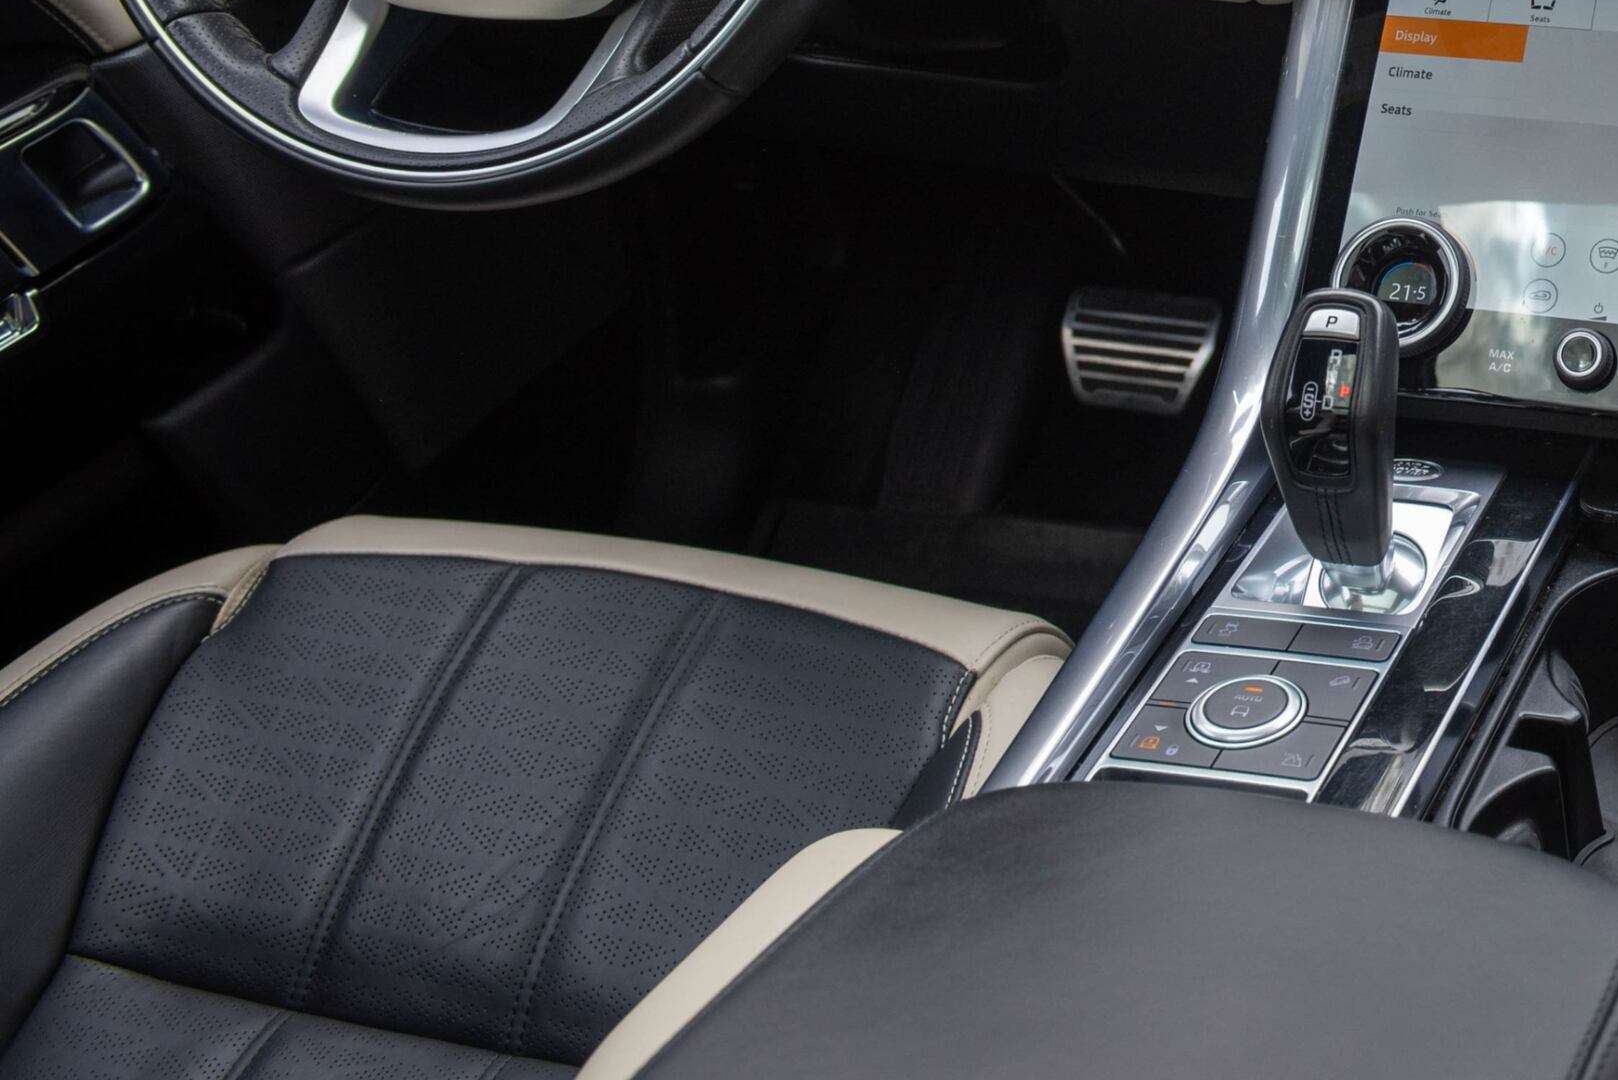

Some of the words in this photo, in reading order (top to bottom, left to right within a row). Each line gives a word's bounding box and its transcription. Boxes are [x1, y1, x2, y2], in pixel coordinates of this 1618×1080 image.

[1424, 7, 1452, 16] Climate
[1529, 14, 1551, 24] Seats
[1395, 30, 1438, 46] Display
[1388, 67, 1433, 80] Climate
[1380, 103, 1413, 116] Seats
[1396, 206, 1415, 217] Push
[1325, 315, 1338, 328] P
[1488, 348, 1515, 360] MAX
[1488, 362, 1512, 373] A/C
[1340, 385, 1351, 397] P
[1303, 394, 1314, 408] S
